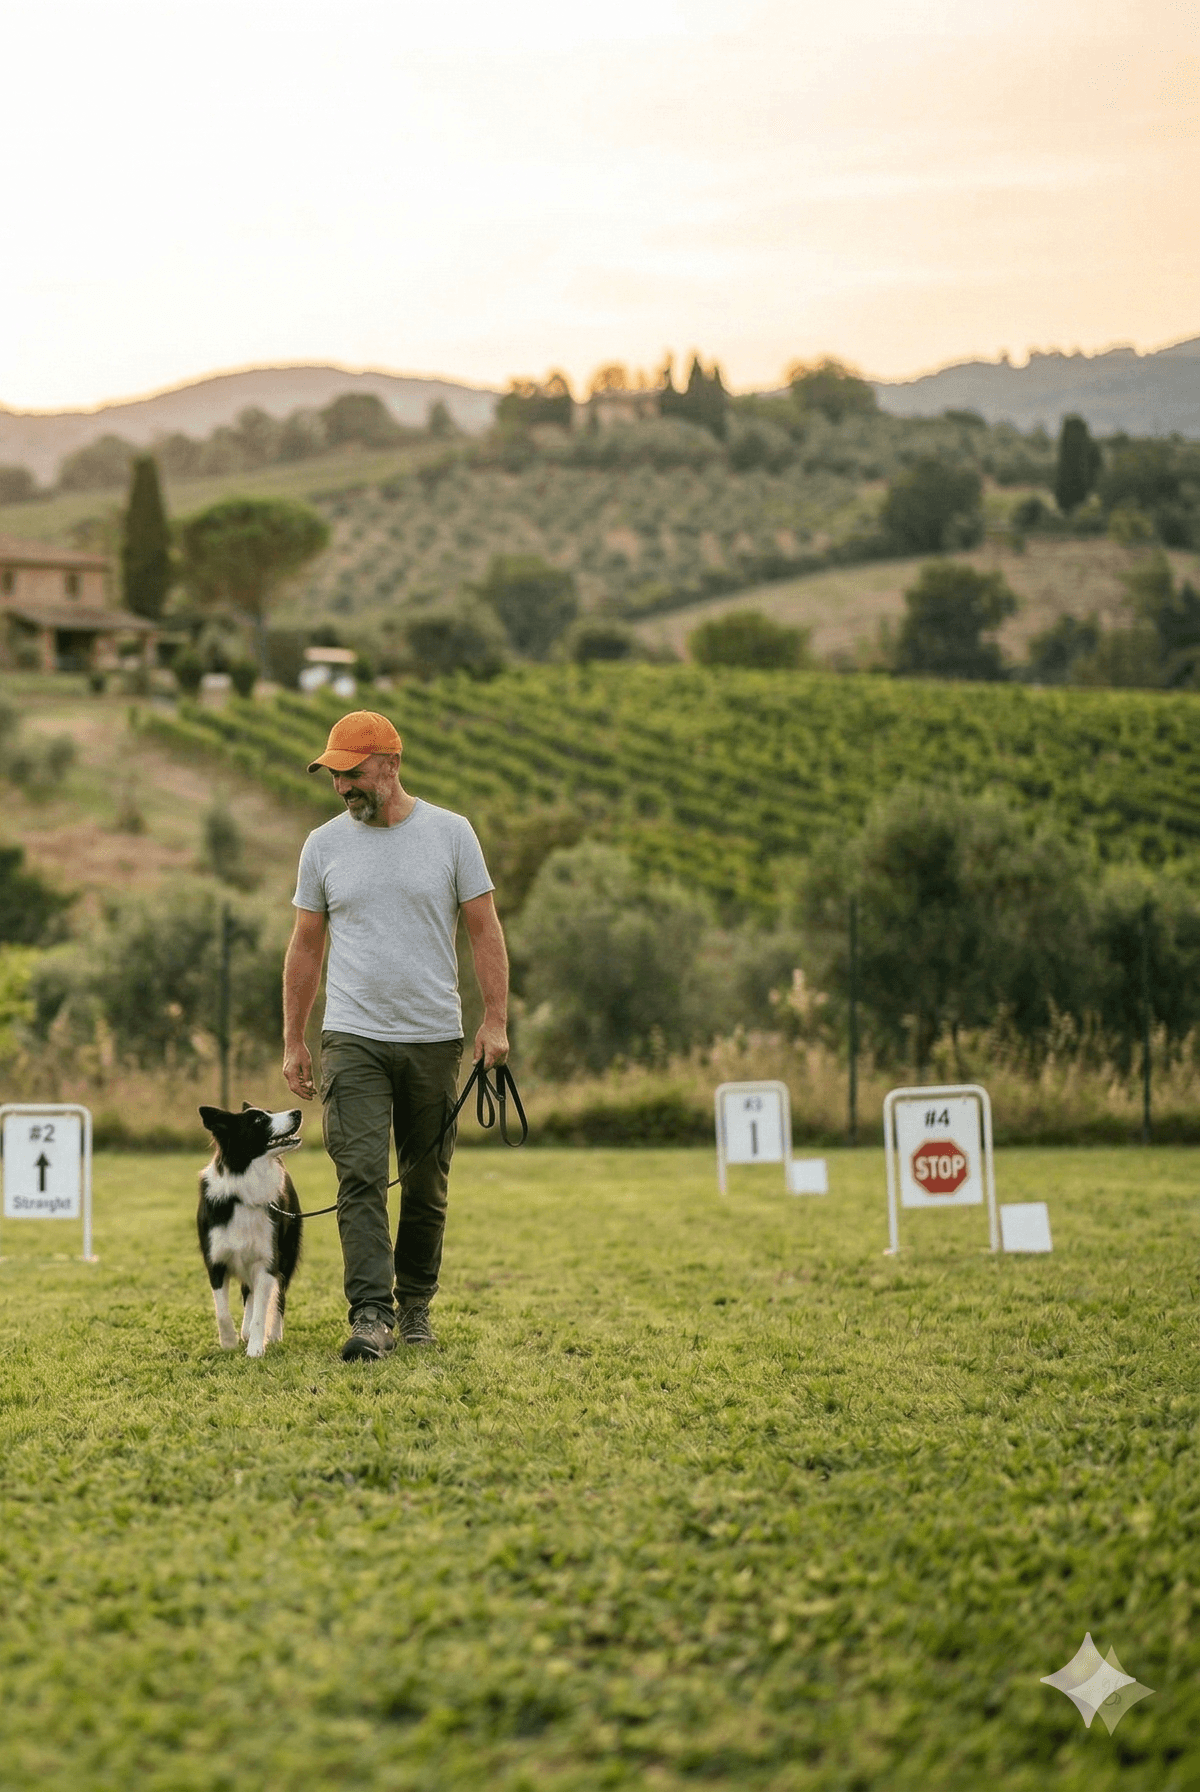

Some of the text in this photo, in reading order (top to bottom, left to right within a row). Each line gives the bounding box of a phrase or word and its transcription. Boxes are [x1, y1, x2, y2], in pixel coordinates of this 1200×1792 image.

[925, 1108, 950, 1127] #4
[29, 1124, 55, 1143] #2
[915, 1154, 966, 1181] STOP
